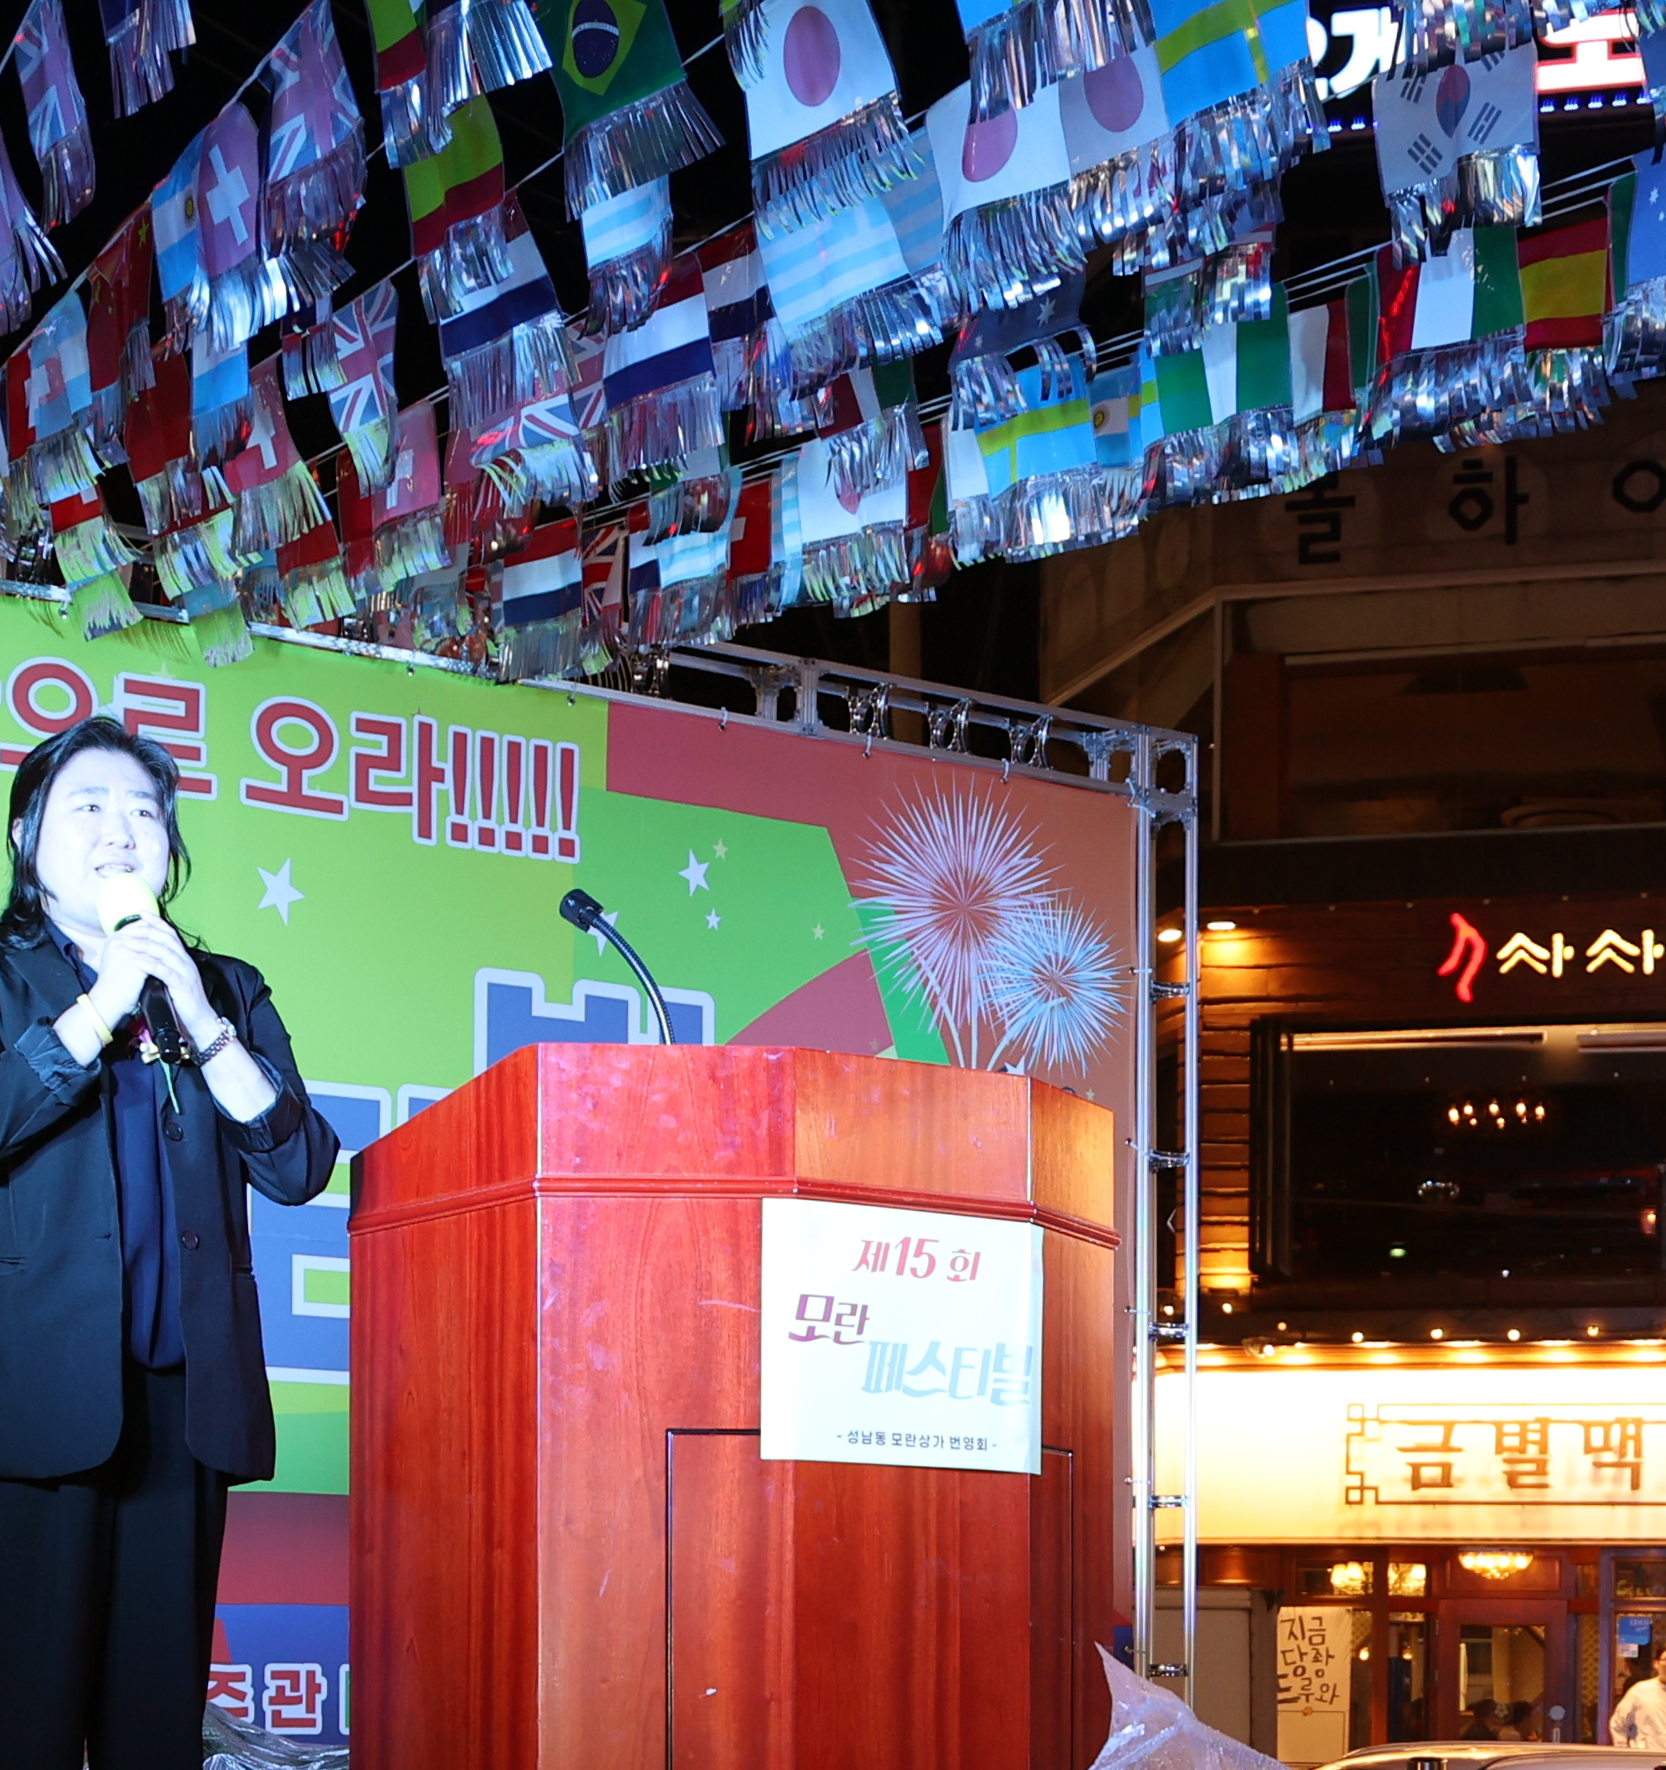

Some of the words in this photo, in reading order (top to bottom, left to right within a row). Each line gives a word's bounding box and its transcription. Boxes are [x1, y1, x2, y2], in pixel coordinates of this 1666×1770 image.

[240, 695, 580, 863] 오라!!!!!
[788, 1293, 870, 1345] 모란
[861, 1340, 1034, 1407] 페스티벌
[847, 1429, 887, 1446] 성남동
[891, 1433, 946, 1450] 모란상가
[949, 1435, 988, 1452] 번영회
[1279, 1615, 1327, 1647] 지금
